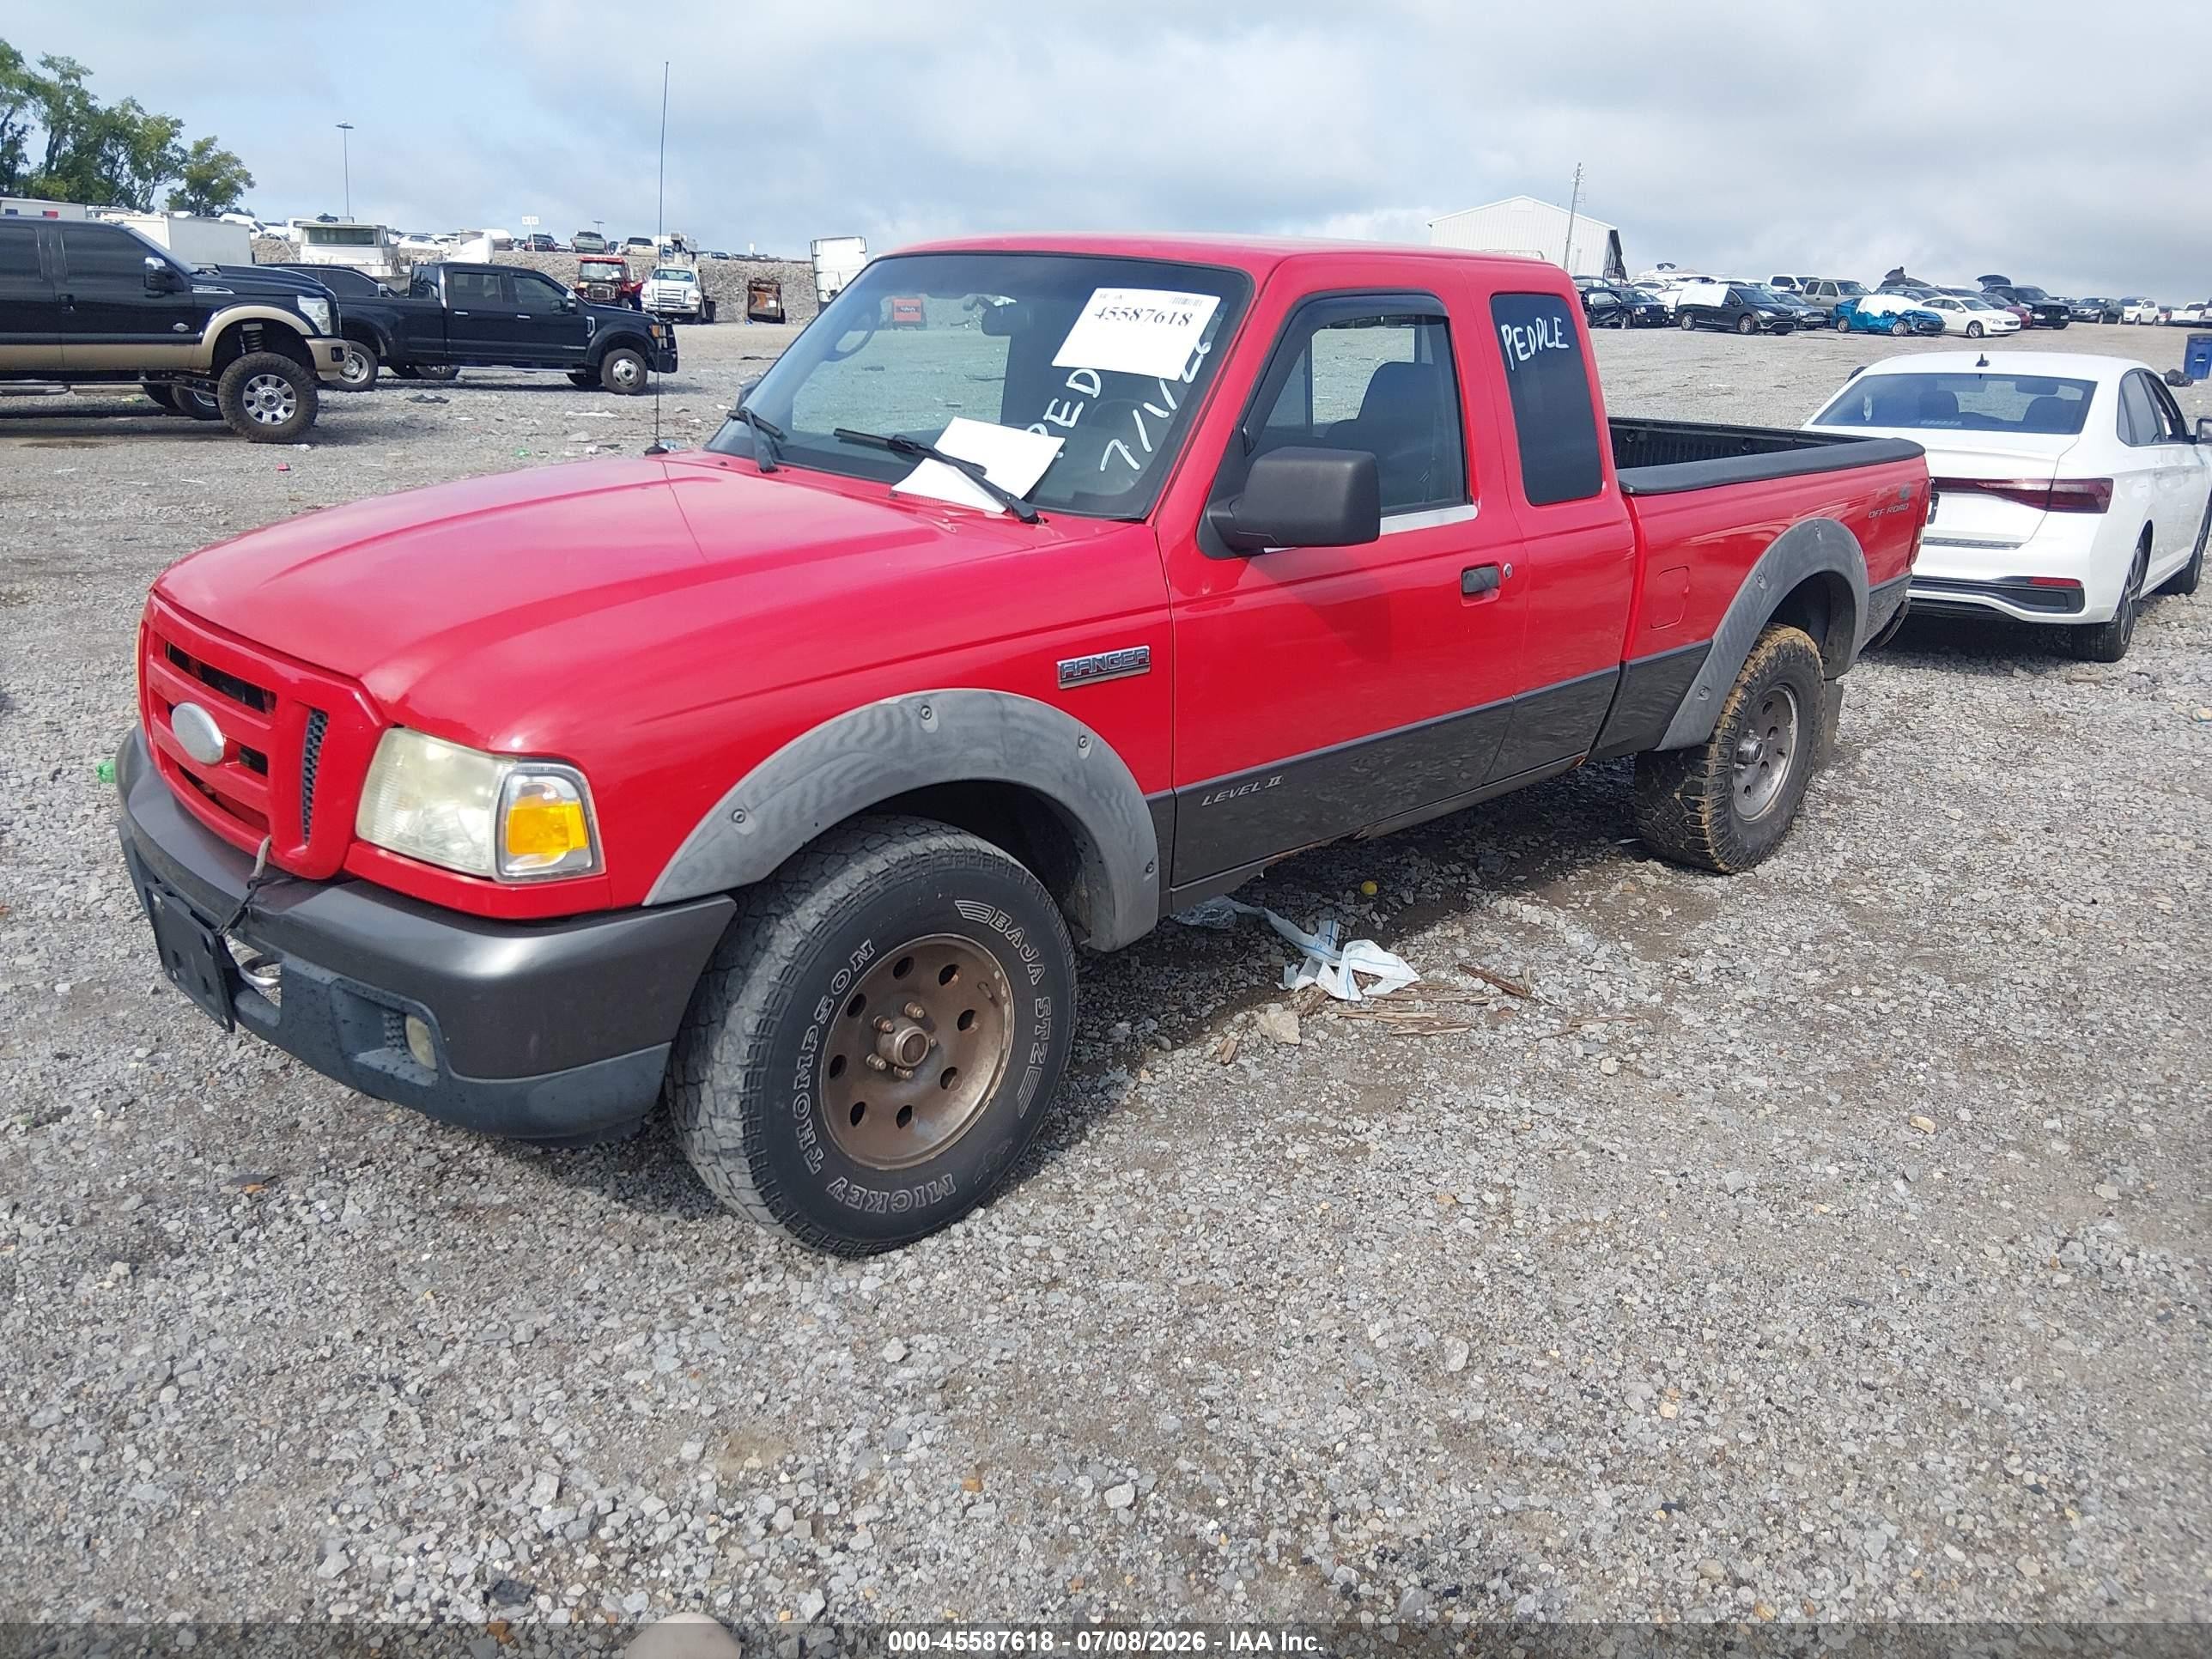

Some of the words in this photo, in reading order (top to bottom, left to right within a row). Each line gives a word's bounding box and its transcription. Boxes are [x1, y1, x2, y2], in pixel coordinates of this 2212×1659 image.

[1094, 306, 1193, 327] 45587618
[1500, 316, 1570, 371] PEDDLE
[1868, 508, 1886, 519] OFF
[1060, 648, 1149, 678] RANGER
[1201, 781, 1261, 806] LEVEL
[1264, 775, 1284, 789] II
[989, 908, 1048, 986] BAJA
[792, 938, 878, 1176] THOMPSON
[825, 1173, 958, 1215] MICKEY
